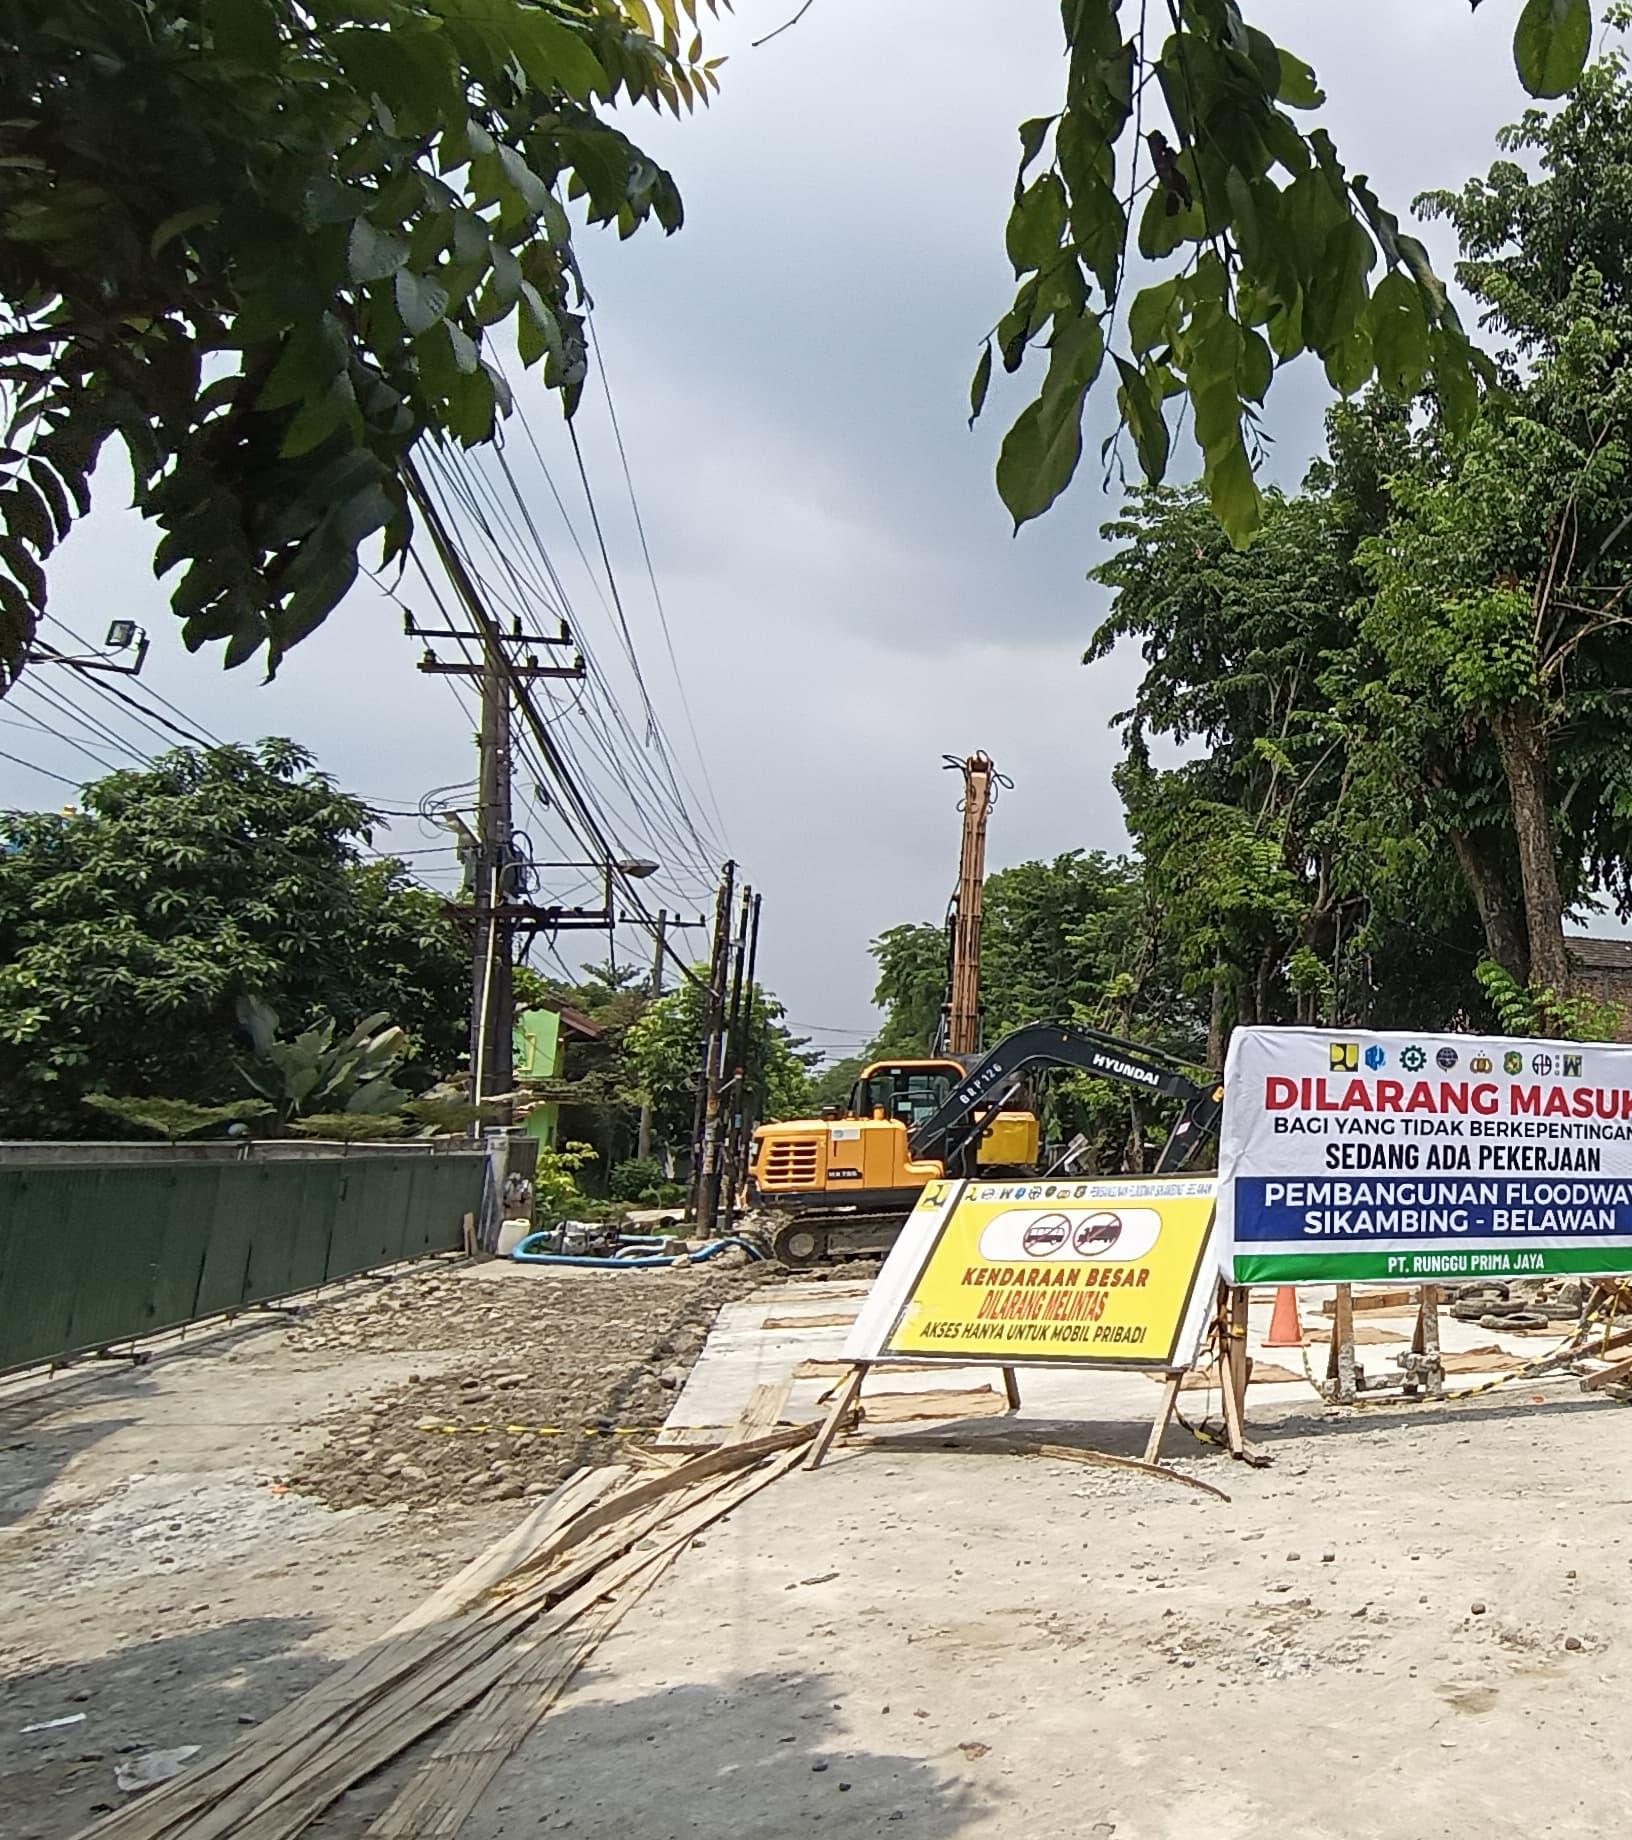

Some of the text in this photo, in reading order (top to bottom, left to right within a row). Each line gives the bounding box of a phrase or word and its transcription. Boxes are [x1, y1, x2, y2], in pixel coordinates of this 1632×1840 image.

[1092, 1054, 1160, 1086] HYUNDAI
[1265, 1076, 1498, 1115] DILARANG
[1274, 1117, 1328, 1134] BAGI
[1335, 1118, 1396, 1134] YANG
[1400, 1119, 1464, 1136] TIDAK
[1326, 1143, 1600, 1172] SEDANG ADA PEKERJAAN
[1265, 1182, 1498, 1206] PEMBANGUNAN
[1303, 1210, 1469, 1234] SIKAMBING
[1492, 1210, 1616, 1232] BELAWAN
[1388, 1254, 1544, 1273] PT. RUNGGU PRIMA JAYA
[962, 1267, 1150, 1288] KENDARAAN BESAR
[977, 1290, 1109, 1322] DILARANG MELINTAS
[920, 1322, 1148, 1344] AKSES HANYA UNTUK MOBIL PRIBADI
